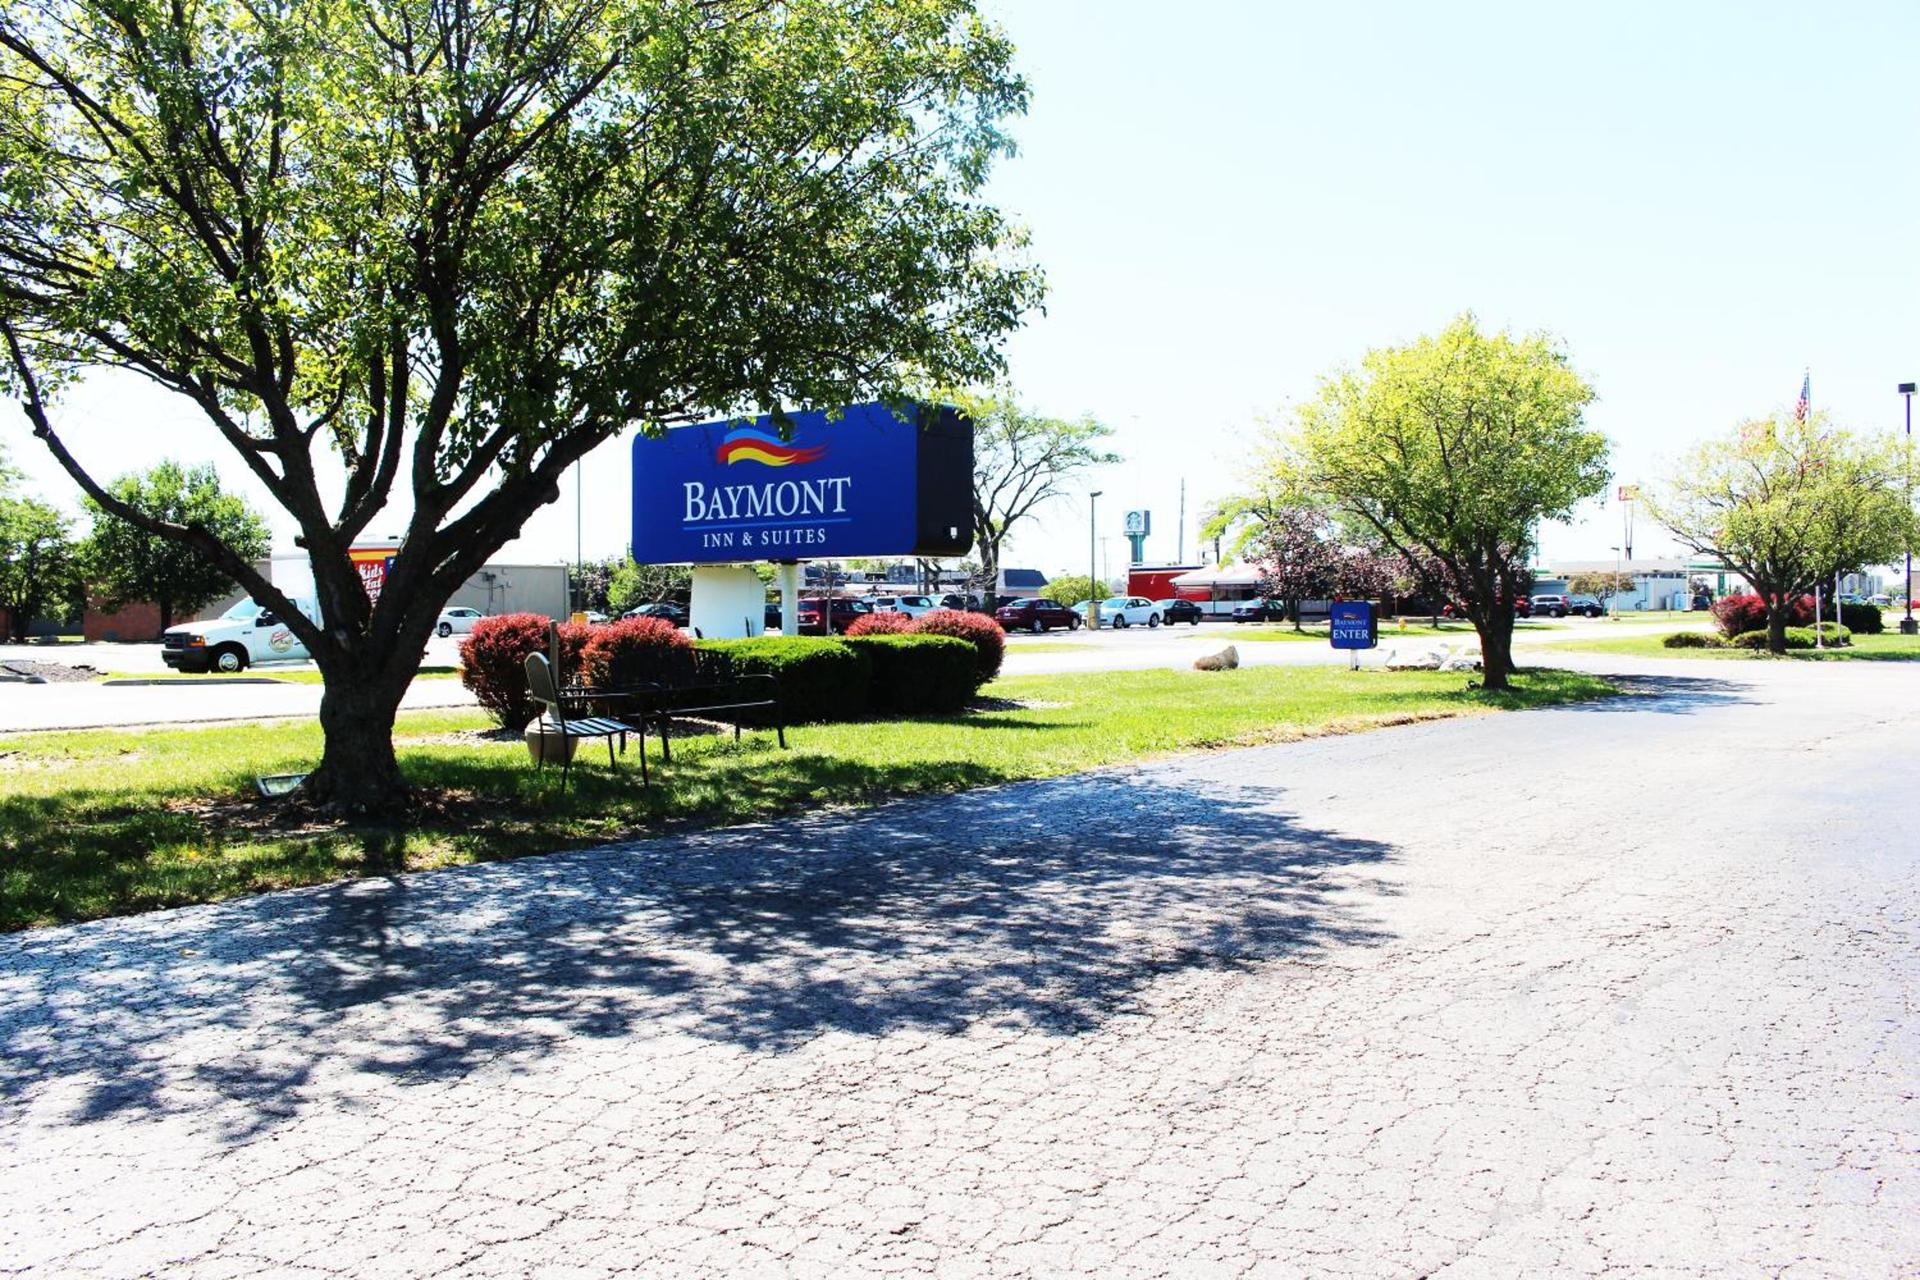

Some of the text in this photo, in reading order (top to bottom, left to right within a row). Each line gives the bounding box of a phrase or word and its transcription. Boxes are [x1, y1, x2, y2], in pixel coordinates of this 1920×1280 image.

[682, 476, 851, 522] BAYMONT
[703, 528, 827, 548] INN & SUITES
[1332, 629, 1369, 640] ENTER
